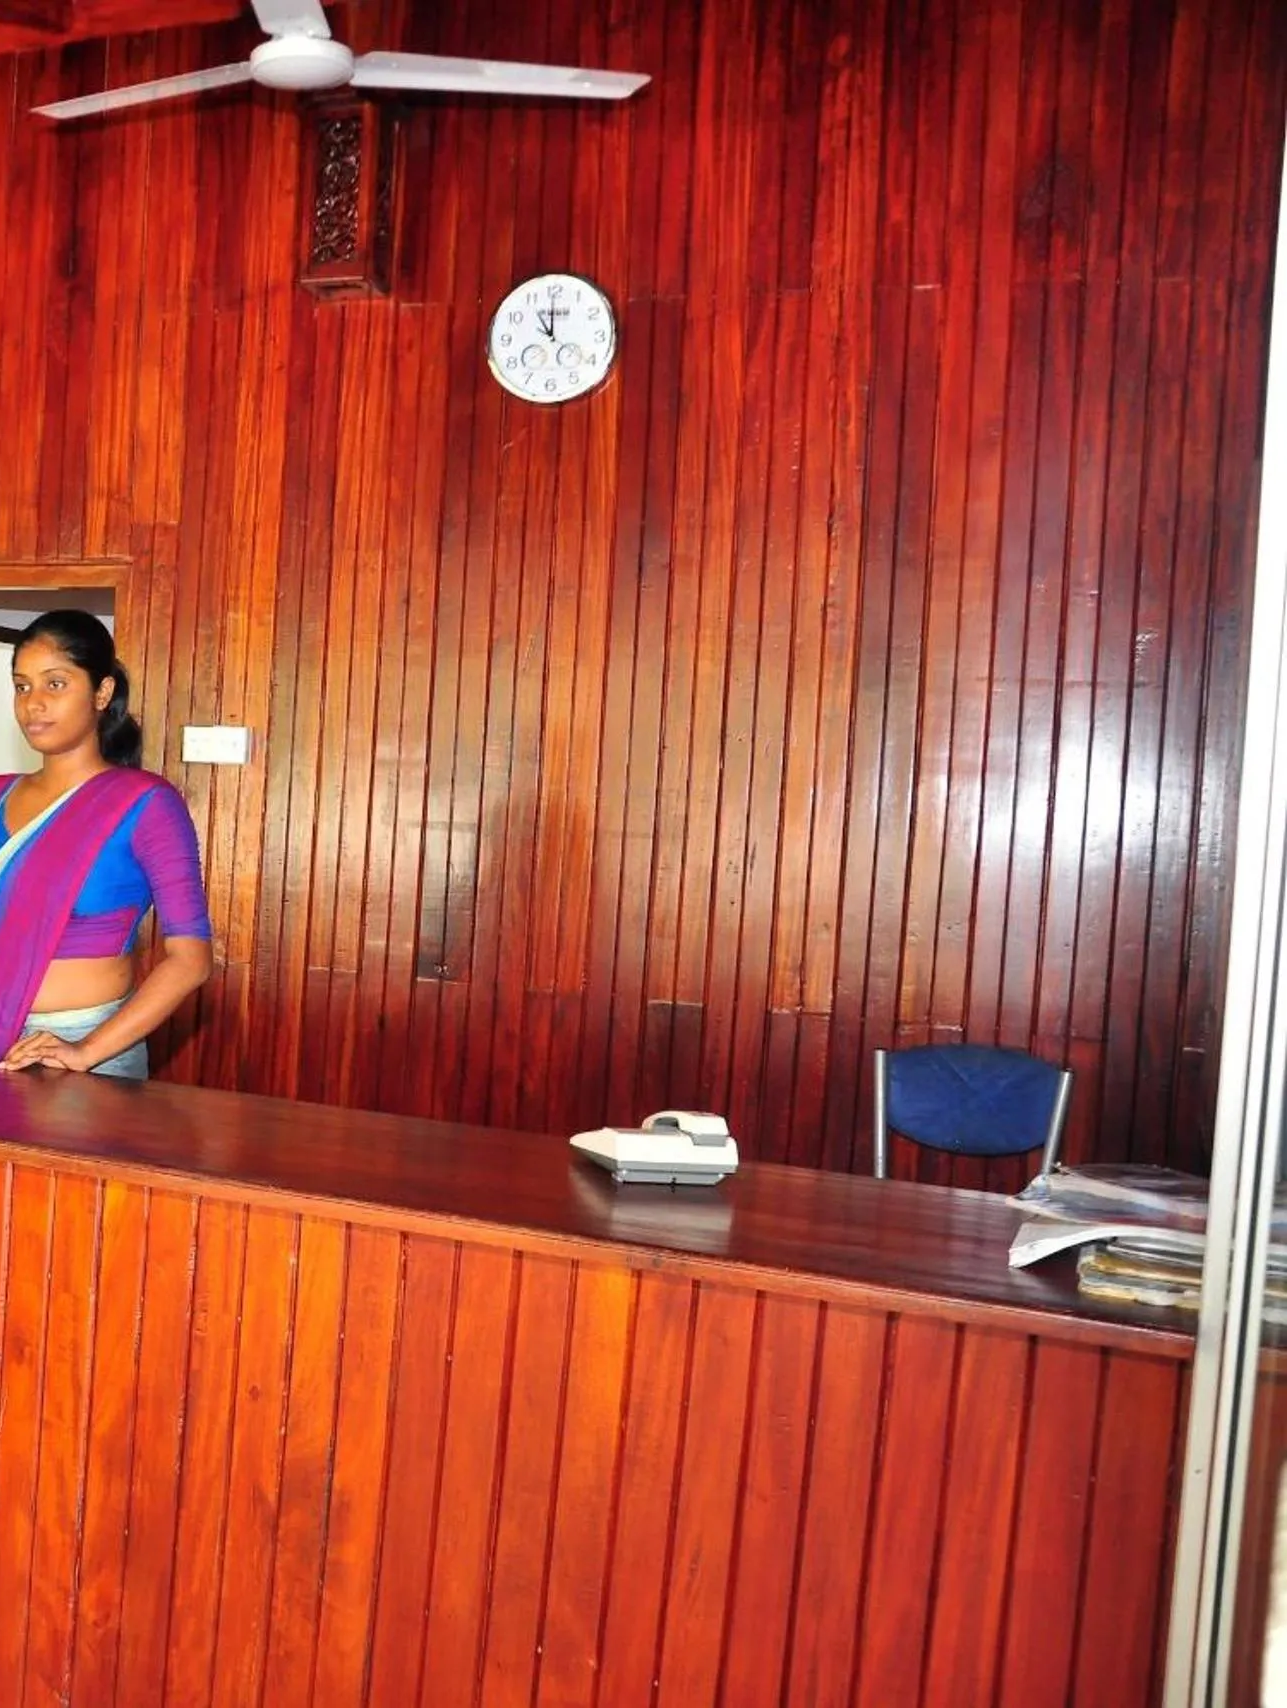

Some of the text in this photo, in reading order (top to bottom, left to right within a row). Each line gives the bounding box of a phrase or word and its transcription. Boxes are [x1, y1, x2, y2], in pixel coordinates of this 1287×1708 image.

[546, 284, 563, 298] 12
[576, 290, 581, 303] 1
[526, 292, 538, 304] 11
[509, 311, 524, 325] 10
[587, 307, 600, 321] 2
[500, 333, 512, 347] 9
[594, 329, 606, 343] 3
[506, 356, 518, 369] 8
[585, 353, 596, 366] 4
[523, 372, 534, 385] 7
[568, 371, 579, 384] 5
[545, 378, 557, 392] 6
